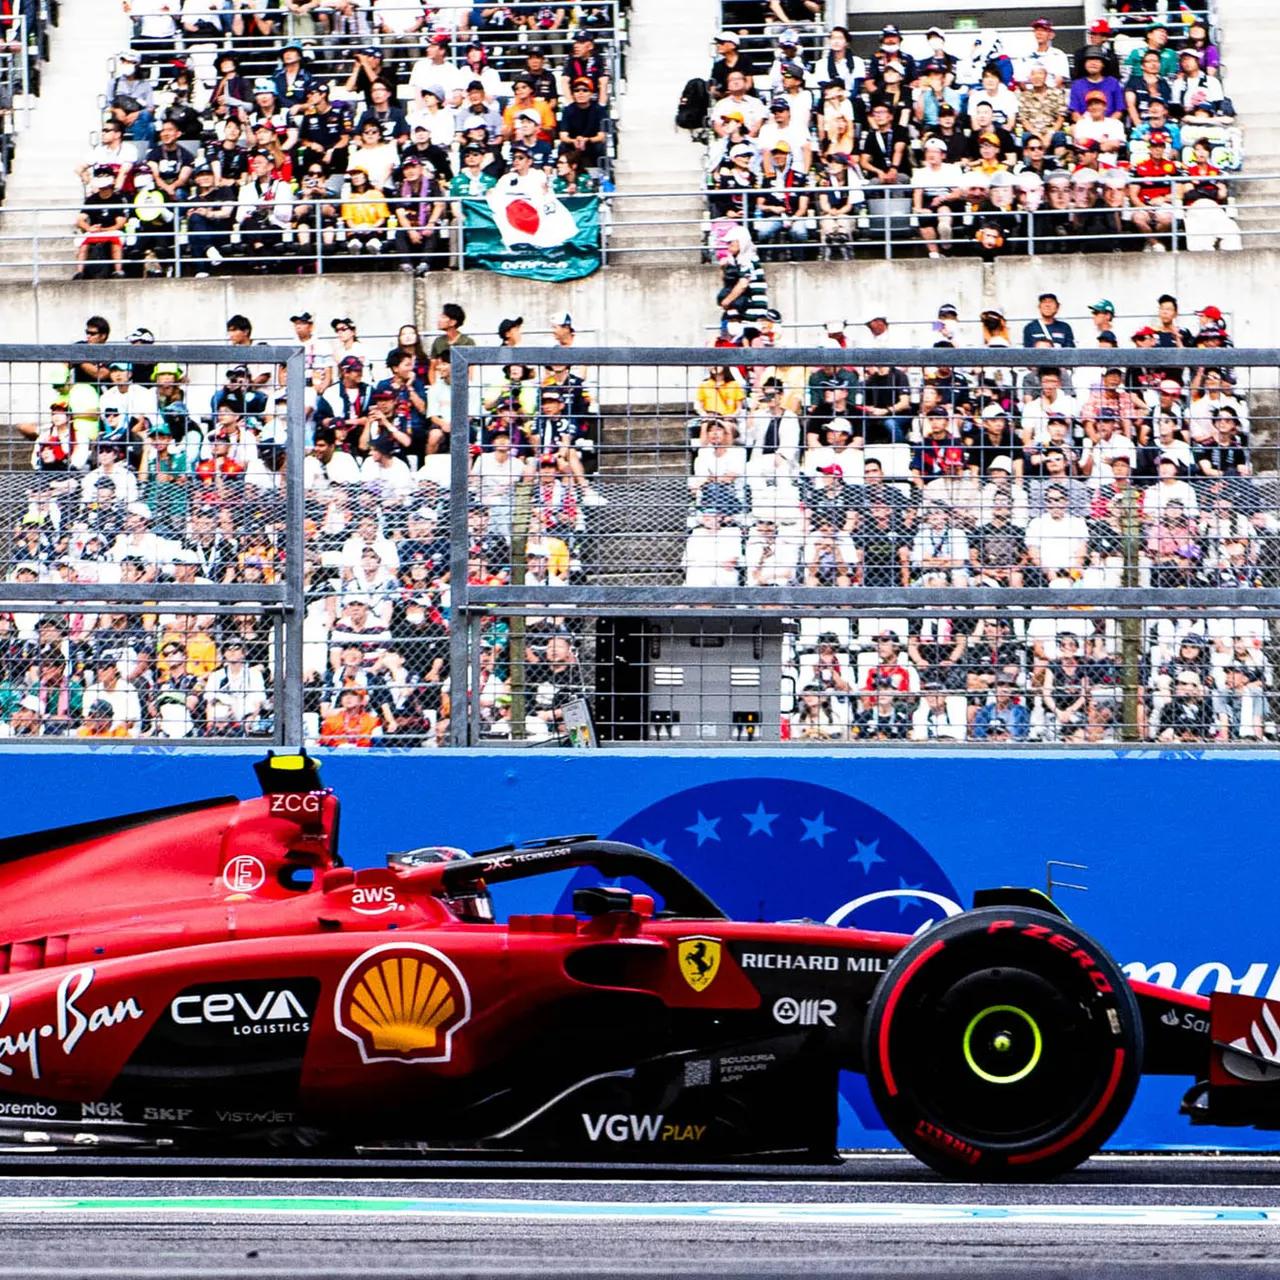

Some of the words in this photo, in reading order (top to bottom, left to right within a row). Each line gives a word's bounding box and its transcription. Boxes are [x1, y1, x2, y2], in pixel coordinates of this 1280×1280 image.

[271, 795, 320, 812] ZCG
[514, 848, 571, 862] TECHNOLOGY
[352, 887, 396, 903] aws
[741, 953, 839, 971] RICHARD
[846, 957, 893, 973] MIL
[1021, 924, 1114, 994] ZERO
[233, 1022, 310, 1036] LOGISTICS
[720, 1053, 776, 1065] SCUDERIA
[720, 1063, 767, 1074] FERRARI
[720, 1074, 743, 1083] APP
[81, 1102, 124, 1117] NGK
[143, 1107, 194, 1121] SKF
[582, 1114, 663, 1141] VGW
[662, 1124, 707, 1142] PLAY
